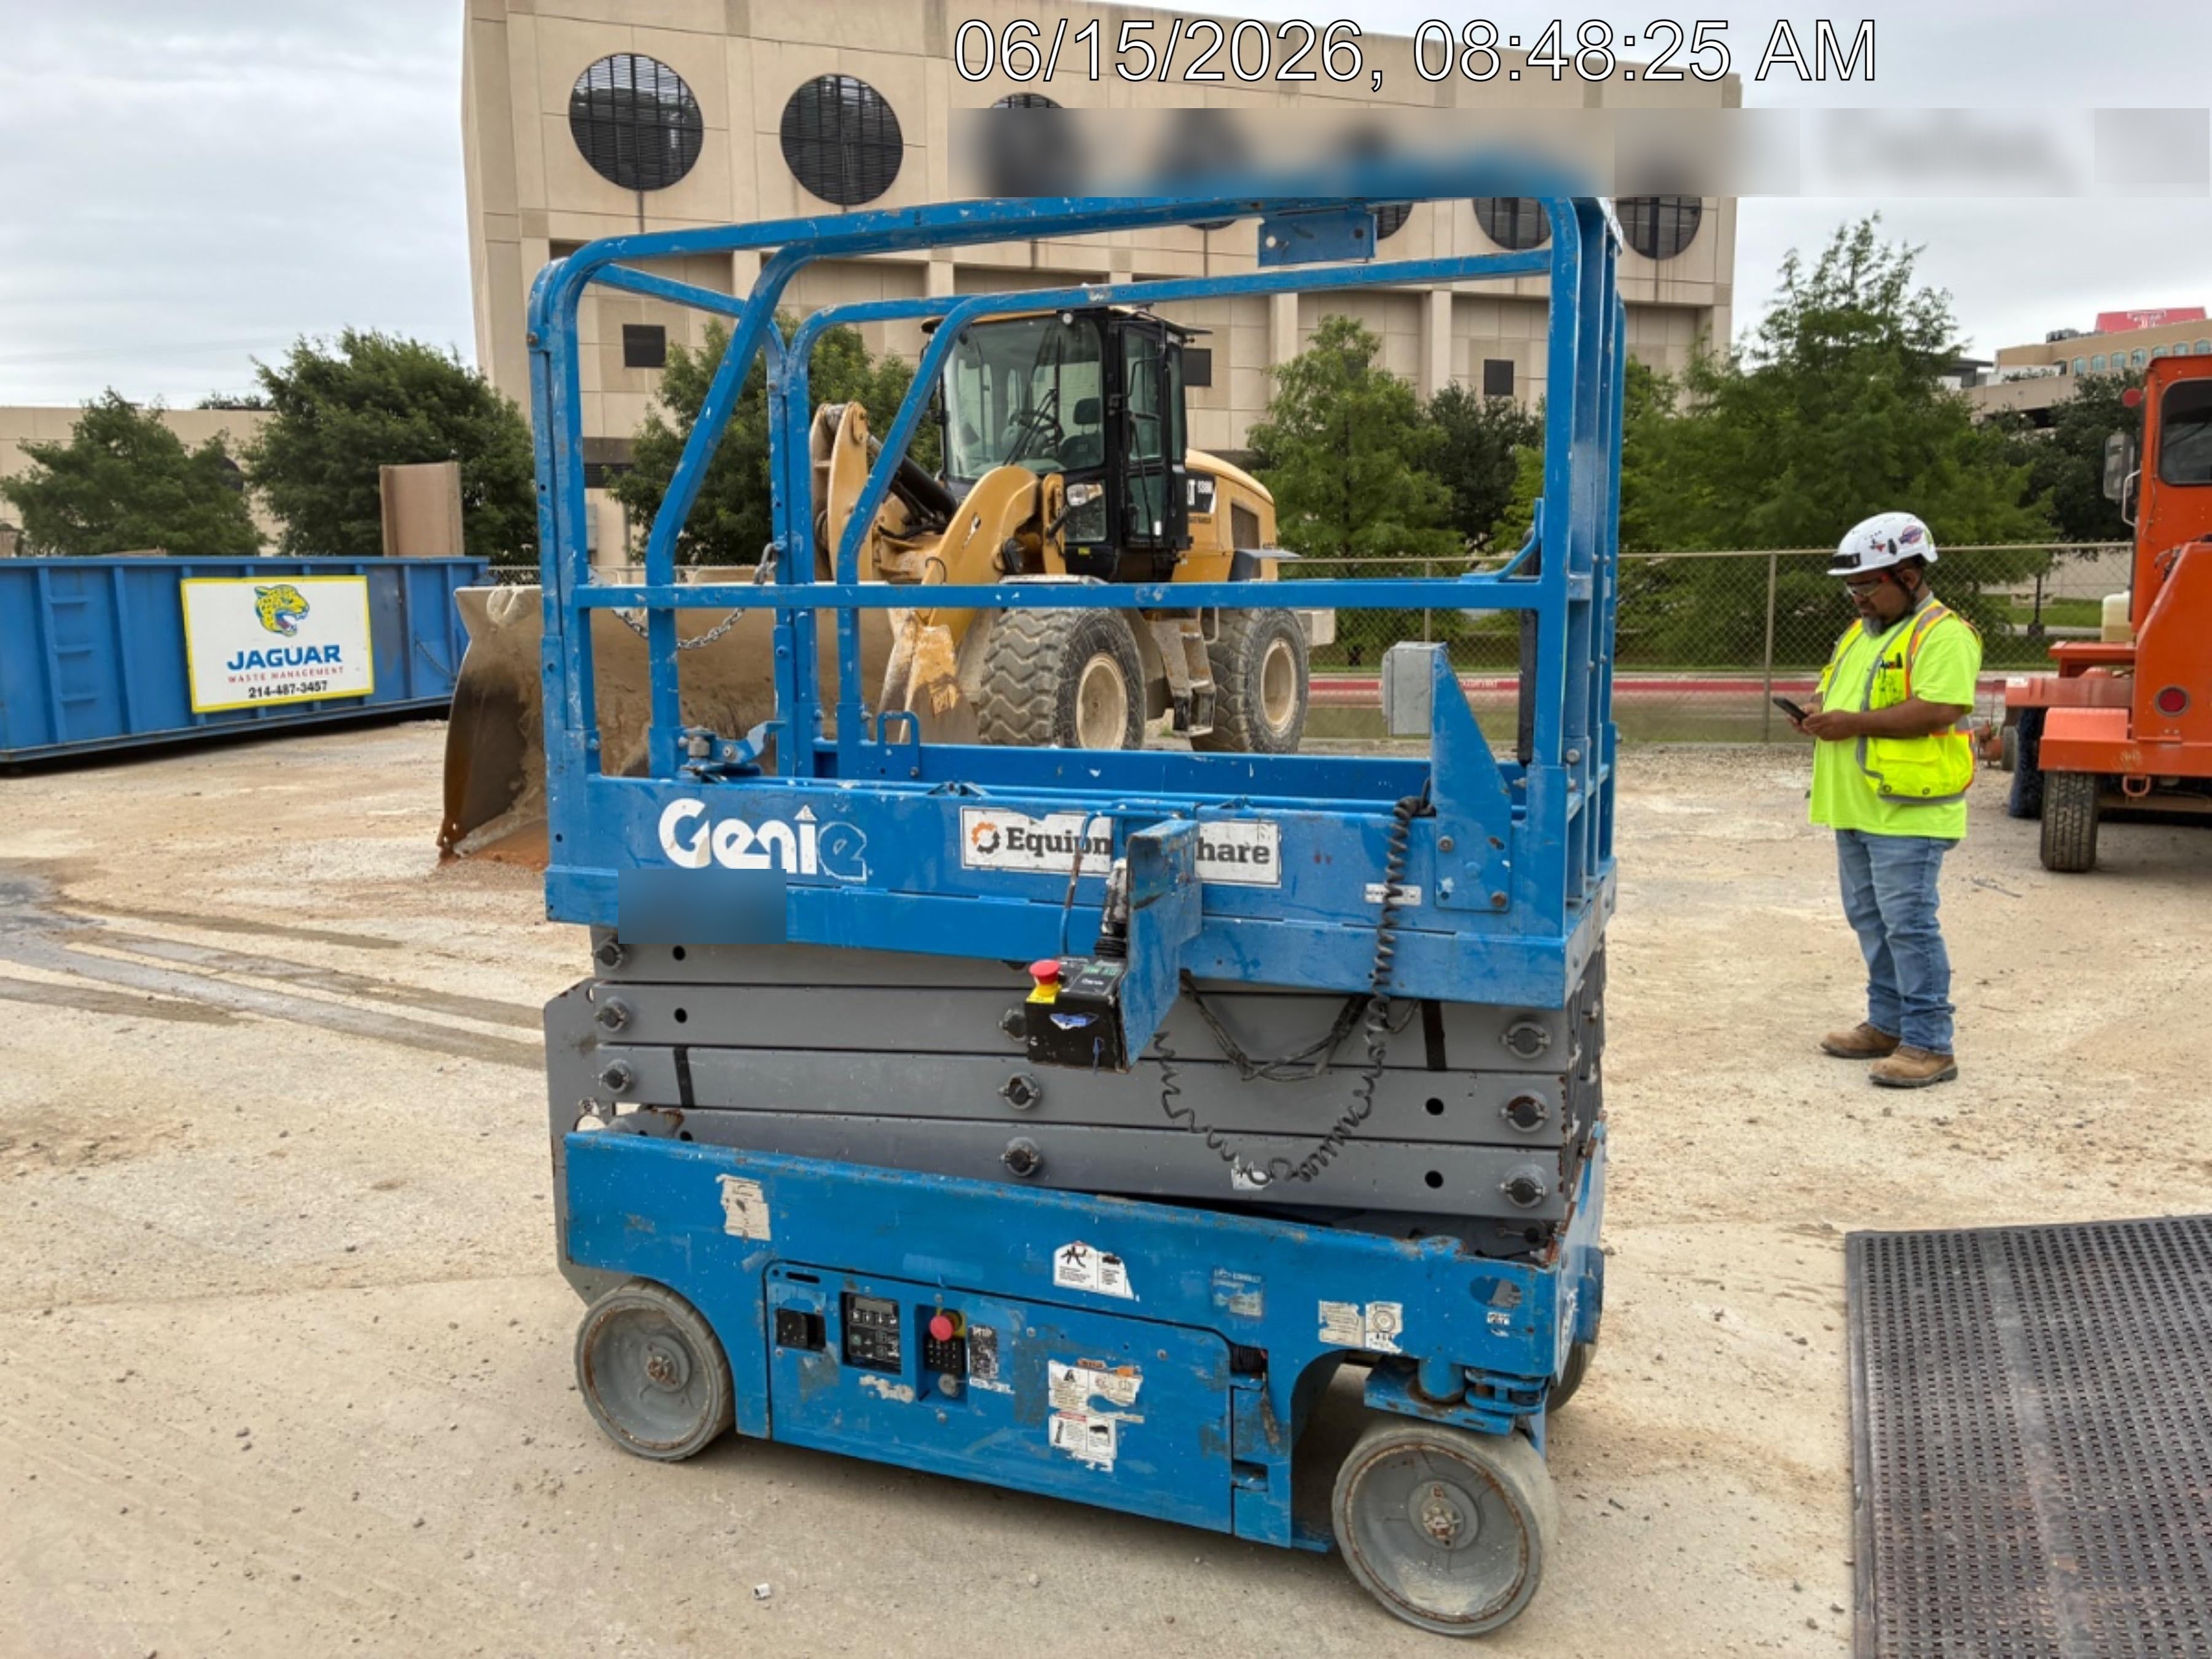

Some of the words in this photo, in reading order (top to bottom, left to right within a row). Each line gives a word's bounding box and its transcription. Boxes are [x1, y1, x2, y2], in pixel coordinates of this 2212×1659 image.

[227, 645, 341, 670] JAGUAR
[228, 673, 265, 683] WASTE
[272, 667, 343, 679] MANAGEMENT
[659, 798, 867, 882] Genie
